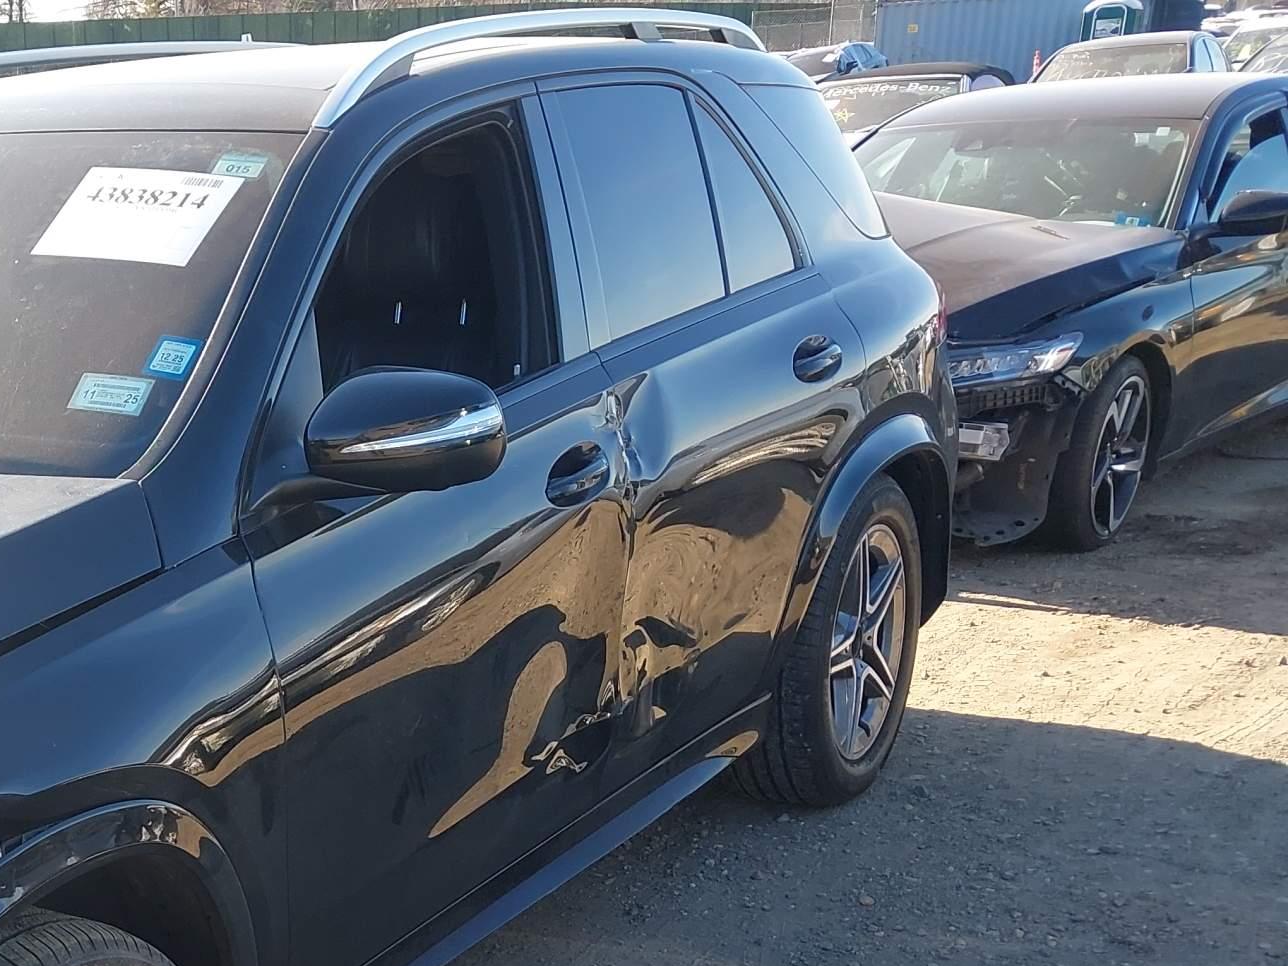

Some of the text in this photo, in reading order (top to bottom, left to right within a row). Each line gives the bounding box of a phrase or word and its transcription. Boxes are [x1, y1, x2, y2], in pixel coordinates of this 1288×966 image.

[225, 164, 251, 174] 015
[87, 186, 210, 209] 43838214
[83, 389, 96, 400] 11
[123, 393, 140, 405] 25
